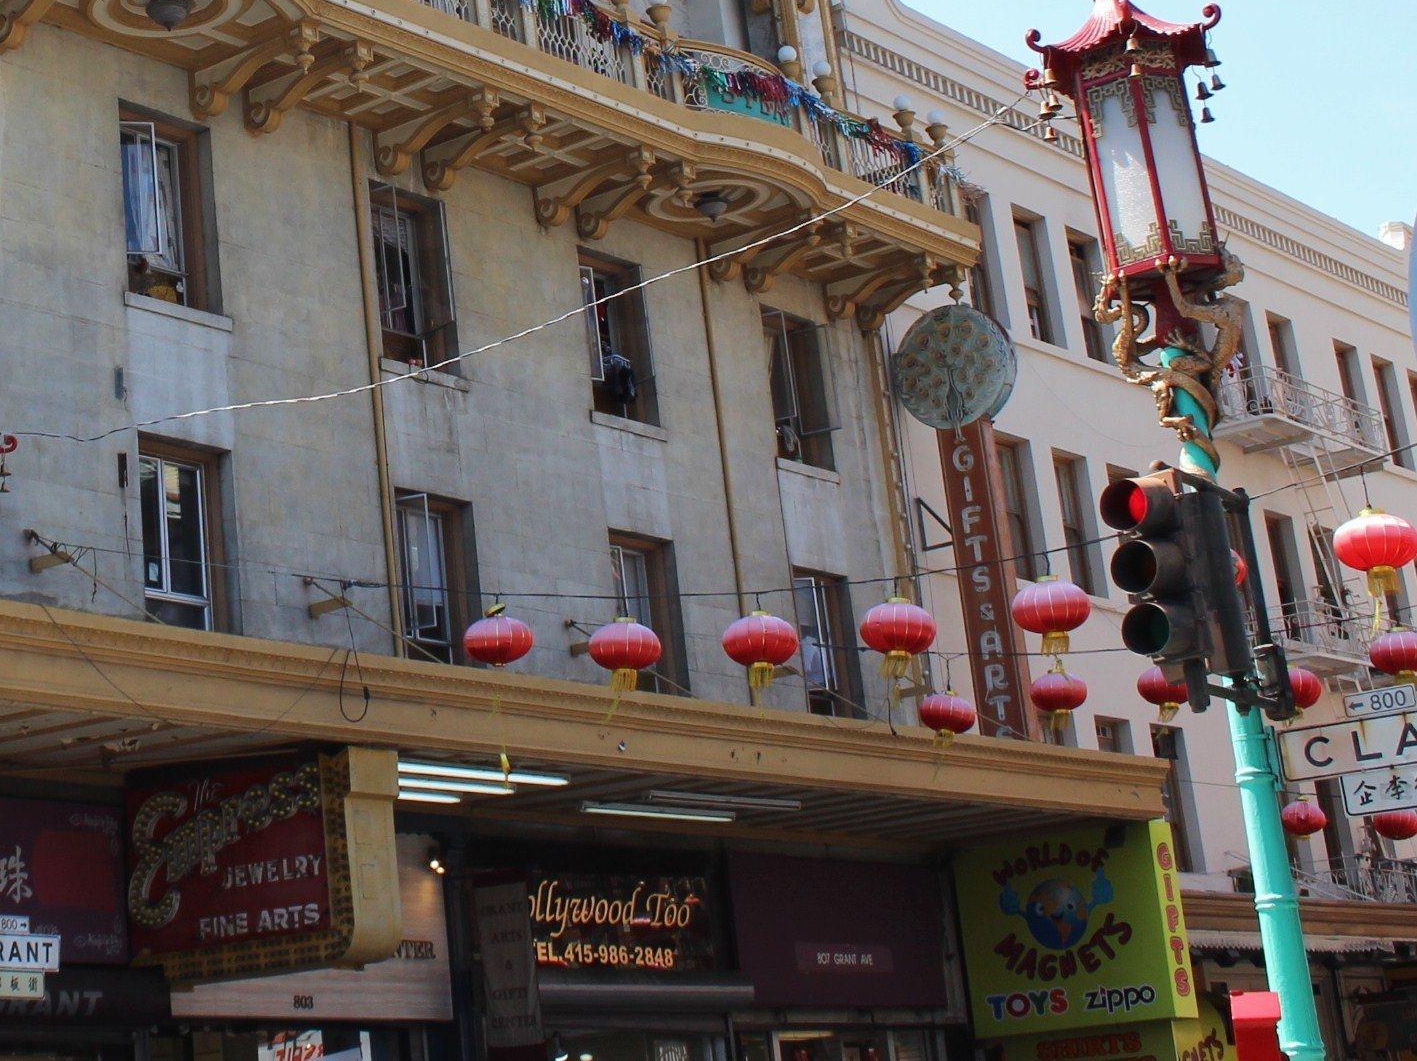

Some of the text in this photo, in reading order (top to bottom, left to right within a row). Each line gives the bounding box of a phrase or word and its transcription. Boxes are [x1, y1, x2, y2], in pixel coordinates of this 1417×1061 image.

[952, 445, 992, 593] GIFTS
[978, 602, 996, 621] &
[1370, 689, 1407, 711] 800
[222, 854, 323, 890] JEWELRY
[992, 841, 1110, 885] WORLD OF
[198, 902, 321, 940] FINE ARTS
[645, 892, 691, 928] Too
[1157, 841, 1191, 997] GIFTS
[817, 952, 874, 966] 807 GRANT AVE
[993, 912, 1134, 983] MAGNETS
[293, 995, 314, 1010] 803
[985, 987, 1070, 1022] TOYS
[1084, 984, 1157, 1015] zippo
